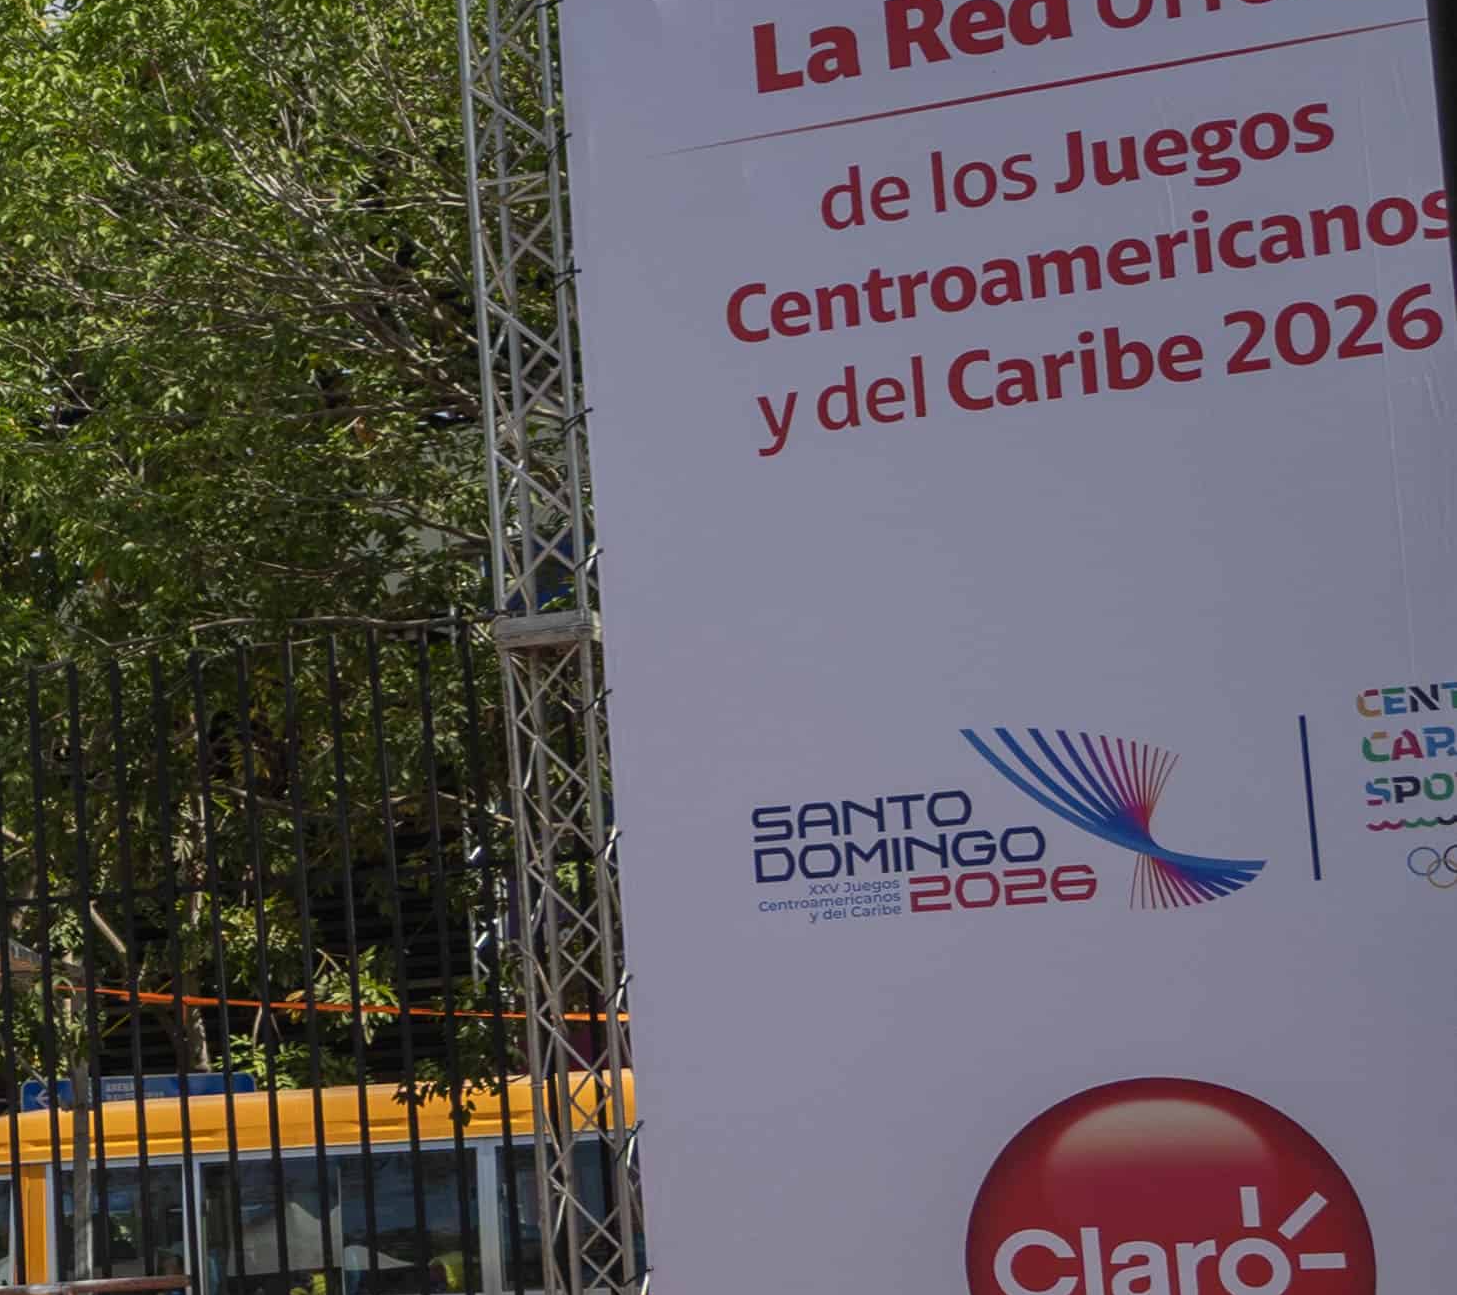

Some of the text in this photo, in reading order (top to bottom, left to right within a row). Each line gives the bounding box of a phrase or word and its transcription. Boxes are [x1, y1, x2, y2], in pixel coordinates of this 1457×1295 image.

[752, 23, 861, 94] La
[820, 103, 1335, 231] de los Juegos
[727, 190, 1451, 343] Centroamericanos
[757, 282, 1444, 457] y del Caribe 2026
[1365, 772, 1457, 807] SPO
[751, 790, 973, 843] SANTO
[753, 826, 1047, 884] DOMINGO
[758, 891, 902, 913] Centroamericanos
[808, 879, 901, 896] XXV Juegos
[809, 904, 903, 924] y del Caribe
[908, 864, 1098, 913] 2026
